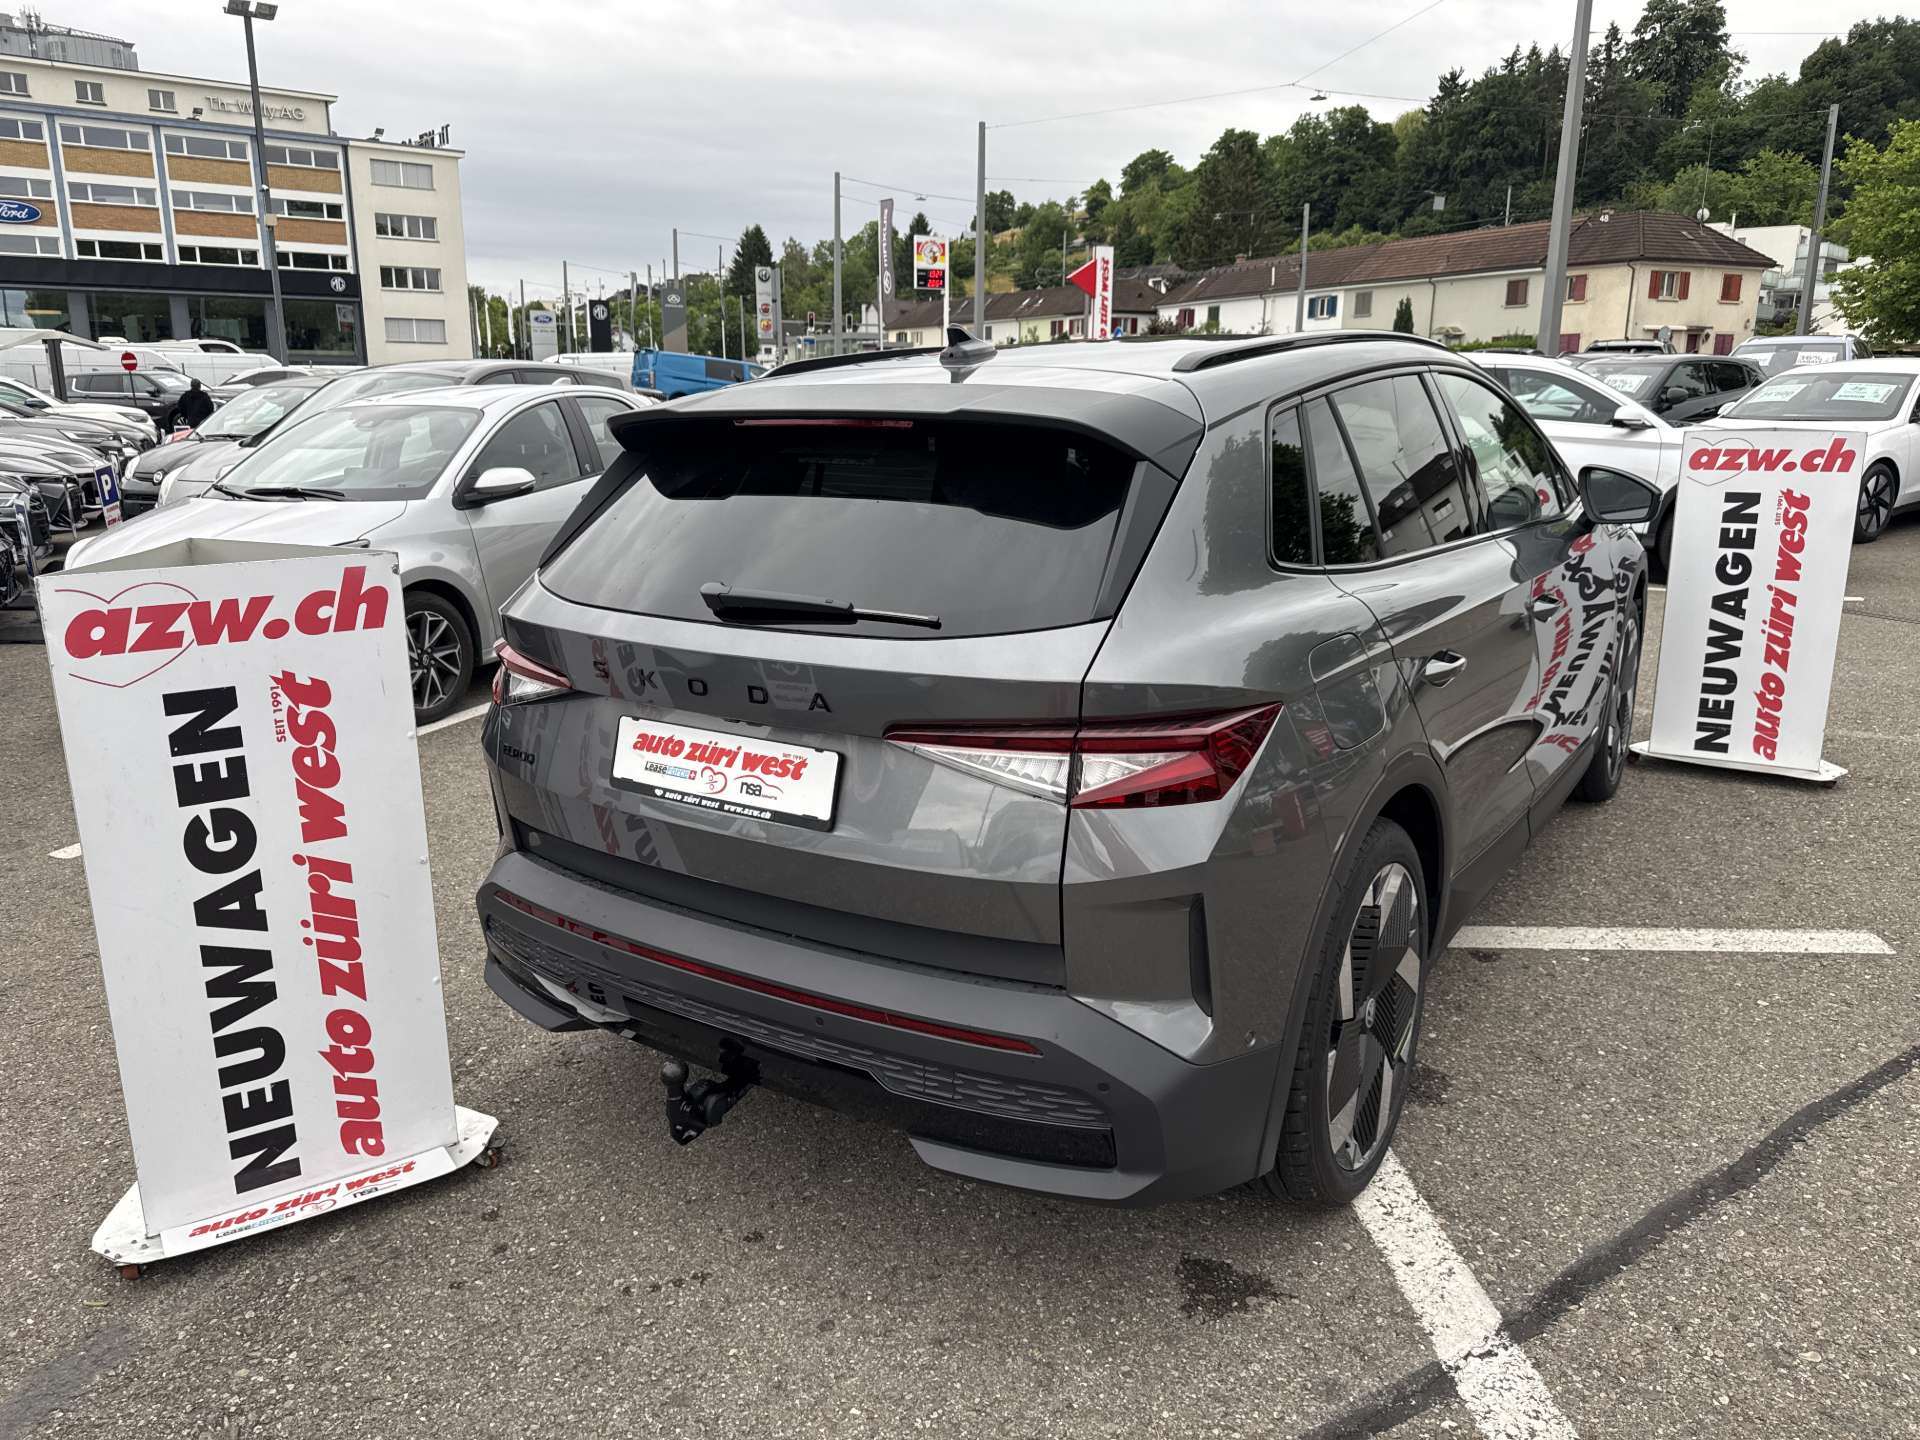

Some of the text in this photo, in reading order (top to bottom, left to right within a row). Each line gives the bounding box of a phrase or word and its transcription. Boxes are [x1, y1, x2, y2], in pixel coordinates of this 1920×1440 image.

[1688, 438, 1857, 474] azw.ch
[101, 474, 111, 500] P
[64, 565, 389, 660] azw.ch
[1693, 491, 1762, 754] NEUWAGEN
[1753, 488, 1811, 761] auto züri west
[270, 686, 287, 742] SEIT 1991
[633, 732, 809, 781] auto züri west
[665, 790, 682, 801] auto
[683, 794, 700, 805] züri
[701, 799, 720, 809] west
[740, 782, 762, 797] nsa
[162, 686, 302, 1194] NEUWAGEN
[269, 670, 386, 1157] auto züri west
[188, 1160, 417, 1238] auto züri west
[353, 1186, 379, 1199] nsa
